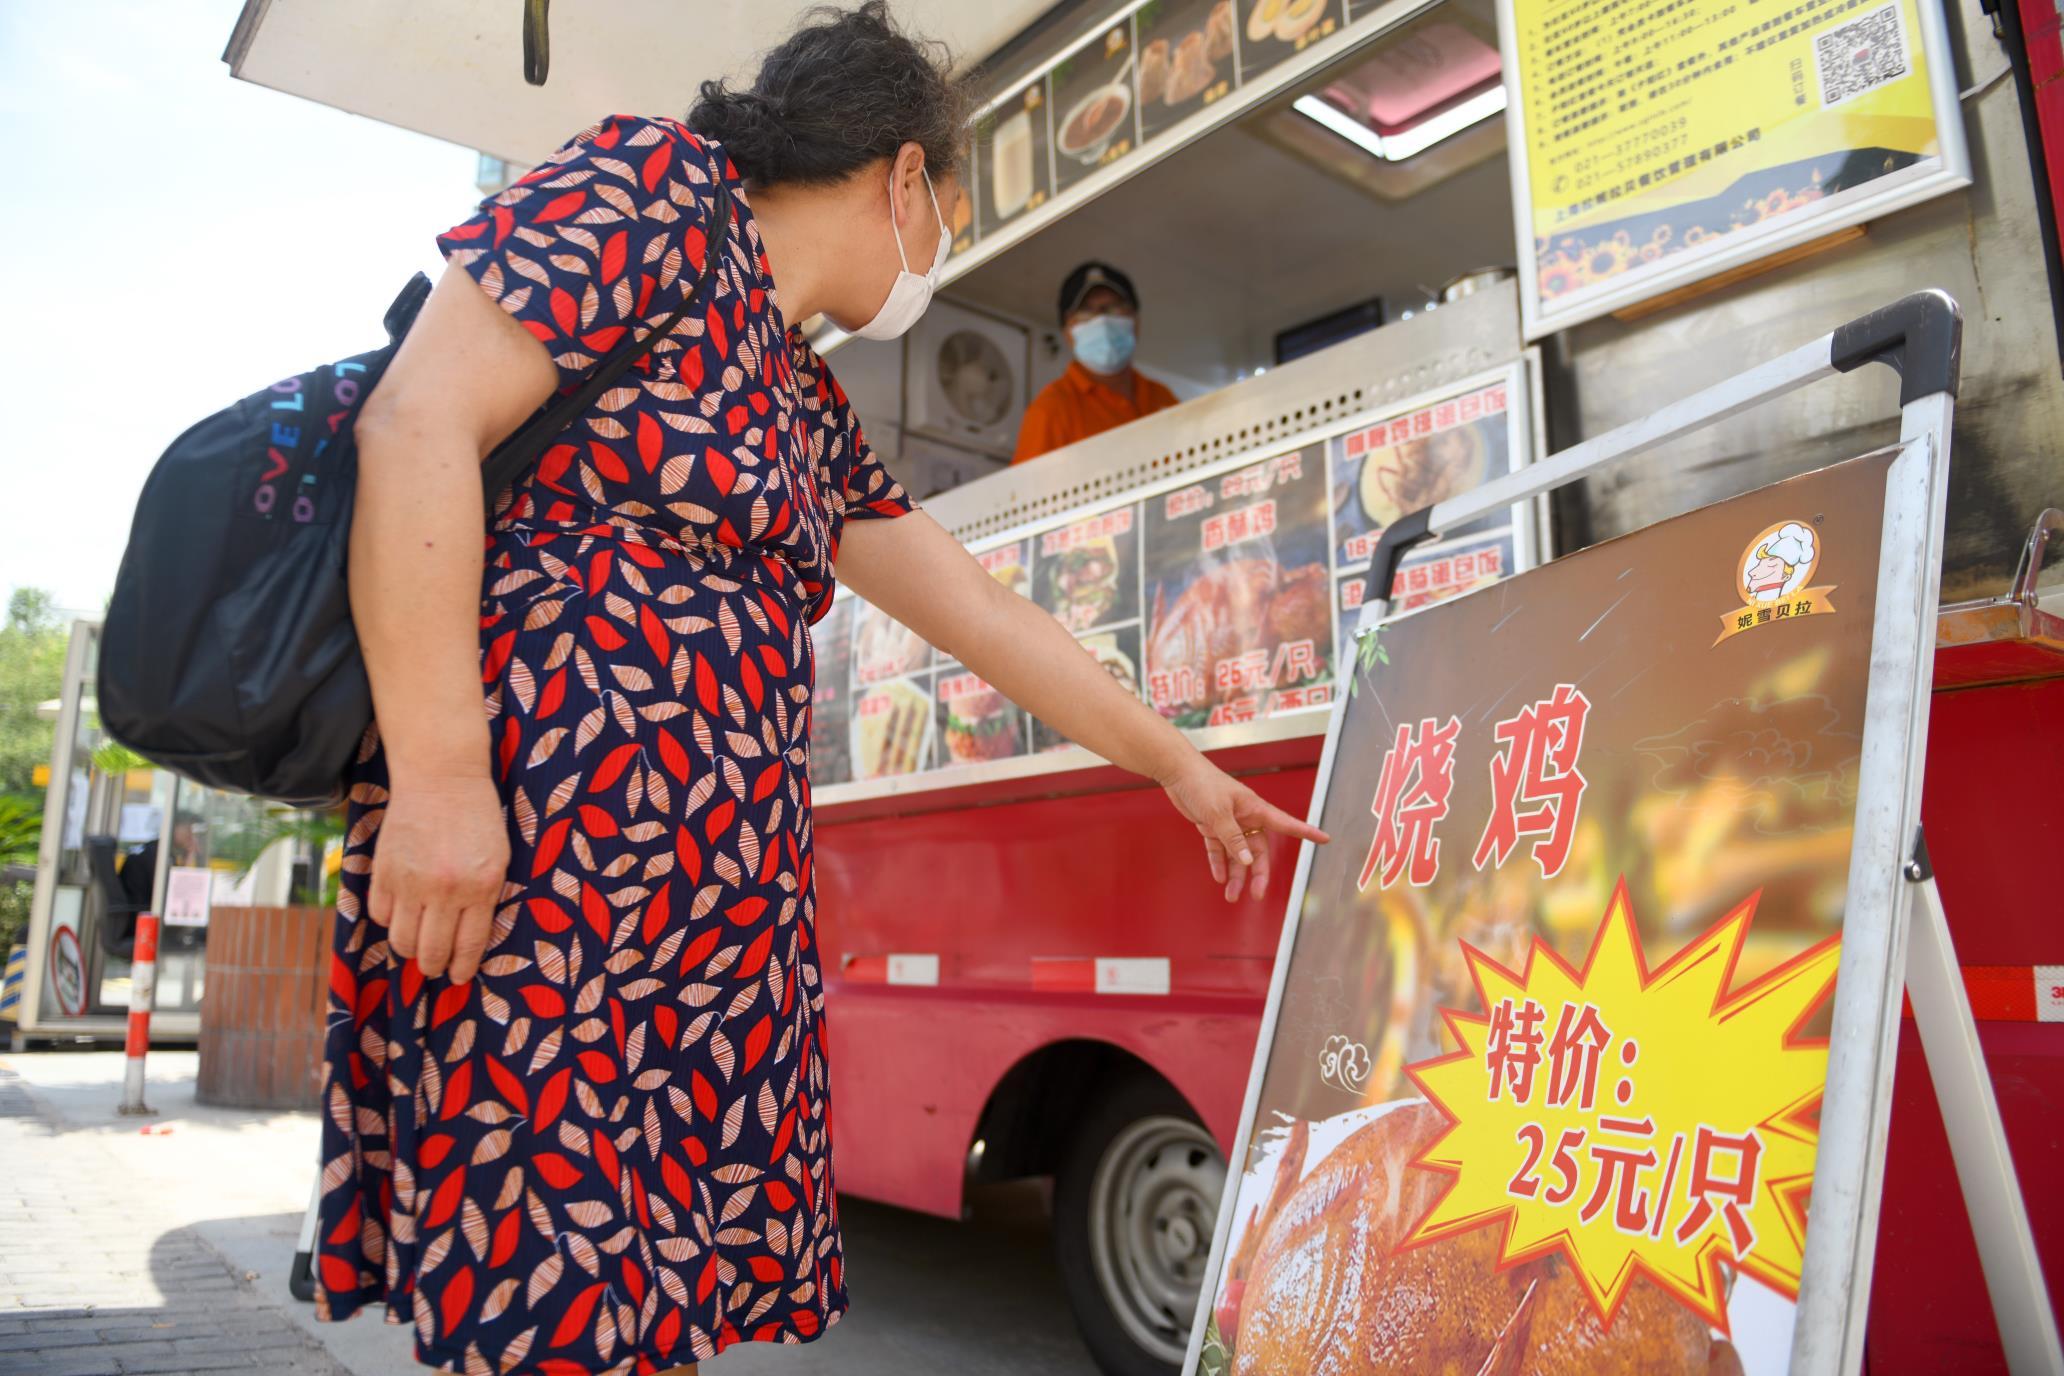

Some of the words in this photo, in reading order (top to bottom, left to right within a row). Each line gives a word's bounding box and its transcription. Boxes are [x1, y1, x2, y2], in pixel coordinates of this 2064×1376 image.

[1217, 640, 1315, 689] 25元/只
[1738, 601, 1812, 629] 妮雪贝拉
[1358, 684, 1590, 891] 烧鸡
[1486, 998, 1637, 1111] 特价：
[1509, 1115, 1765, 1261] 25元/只
